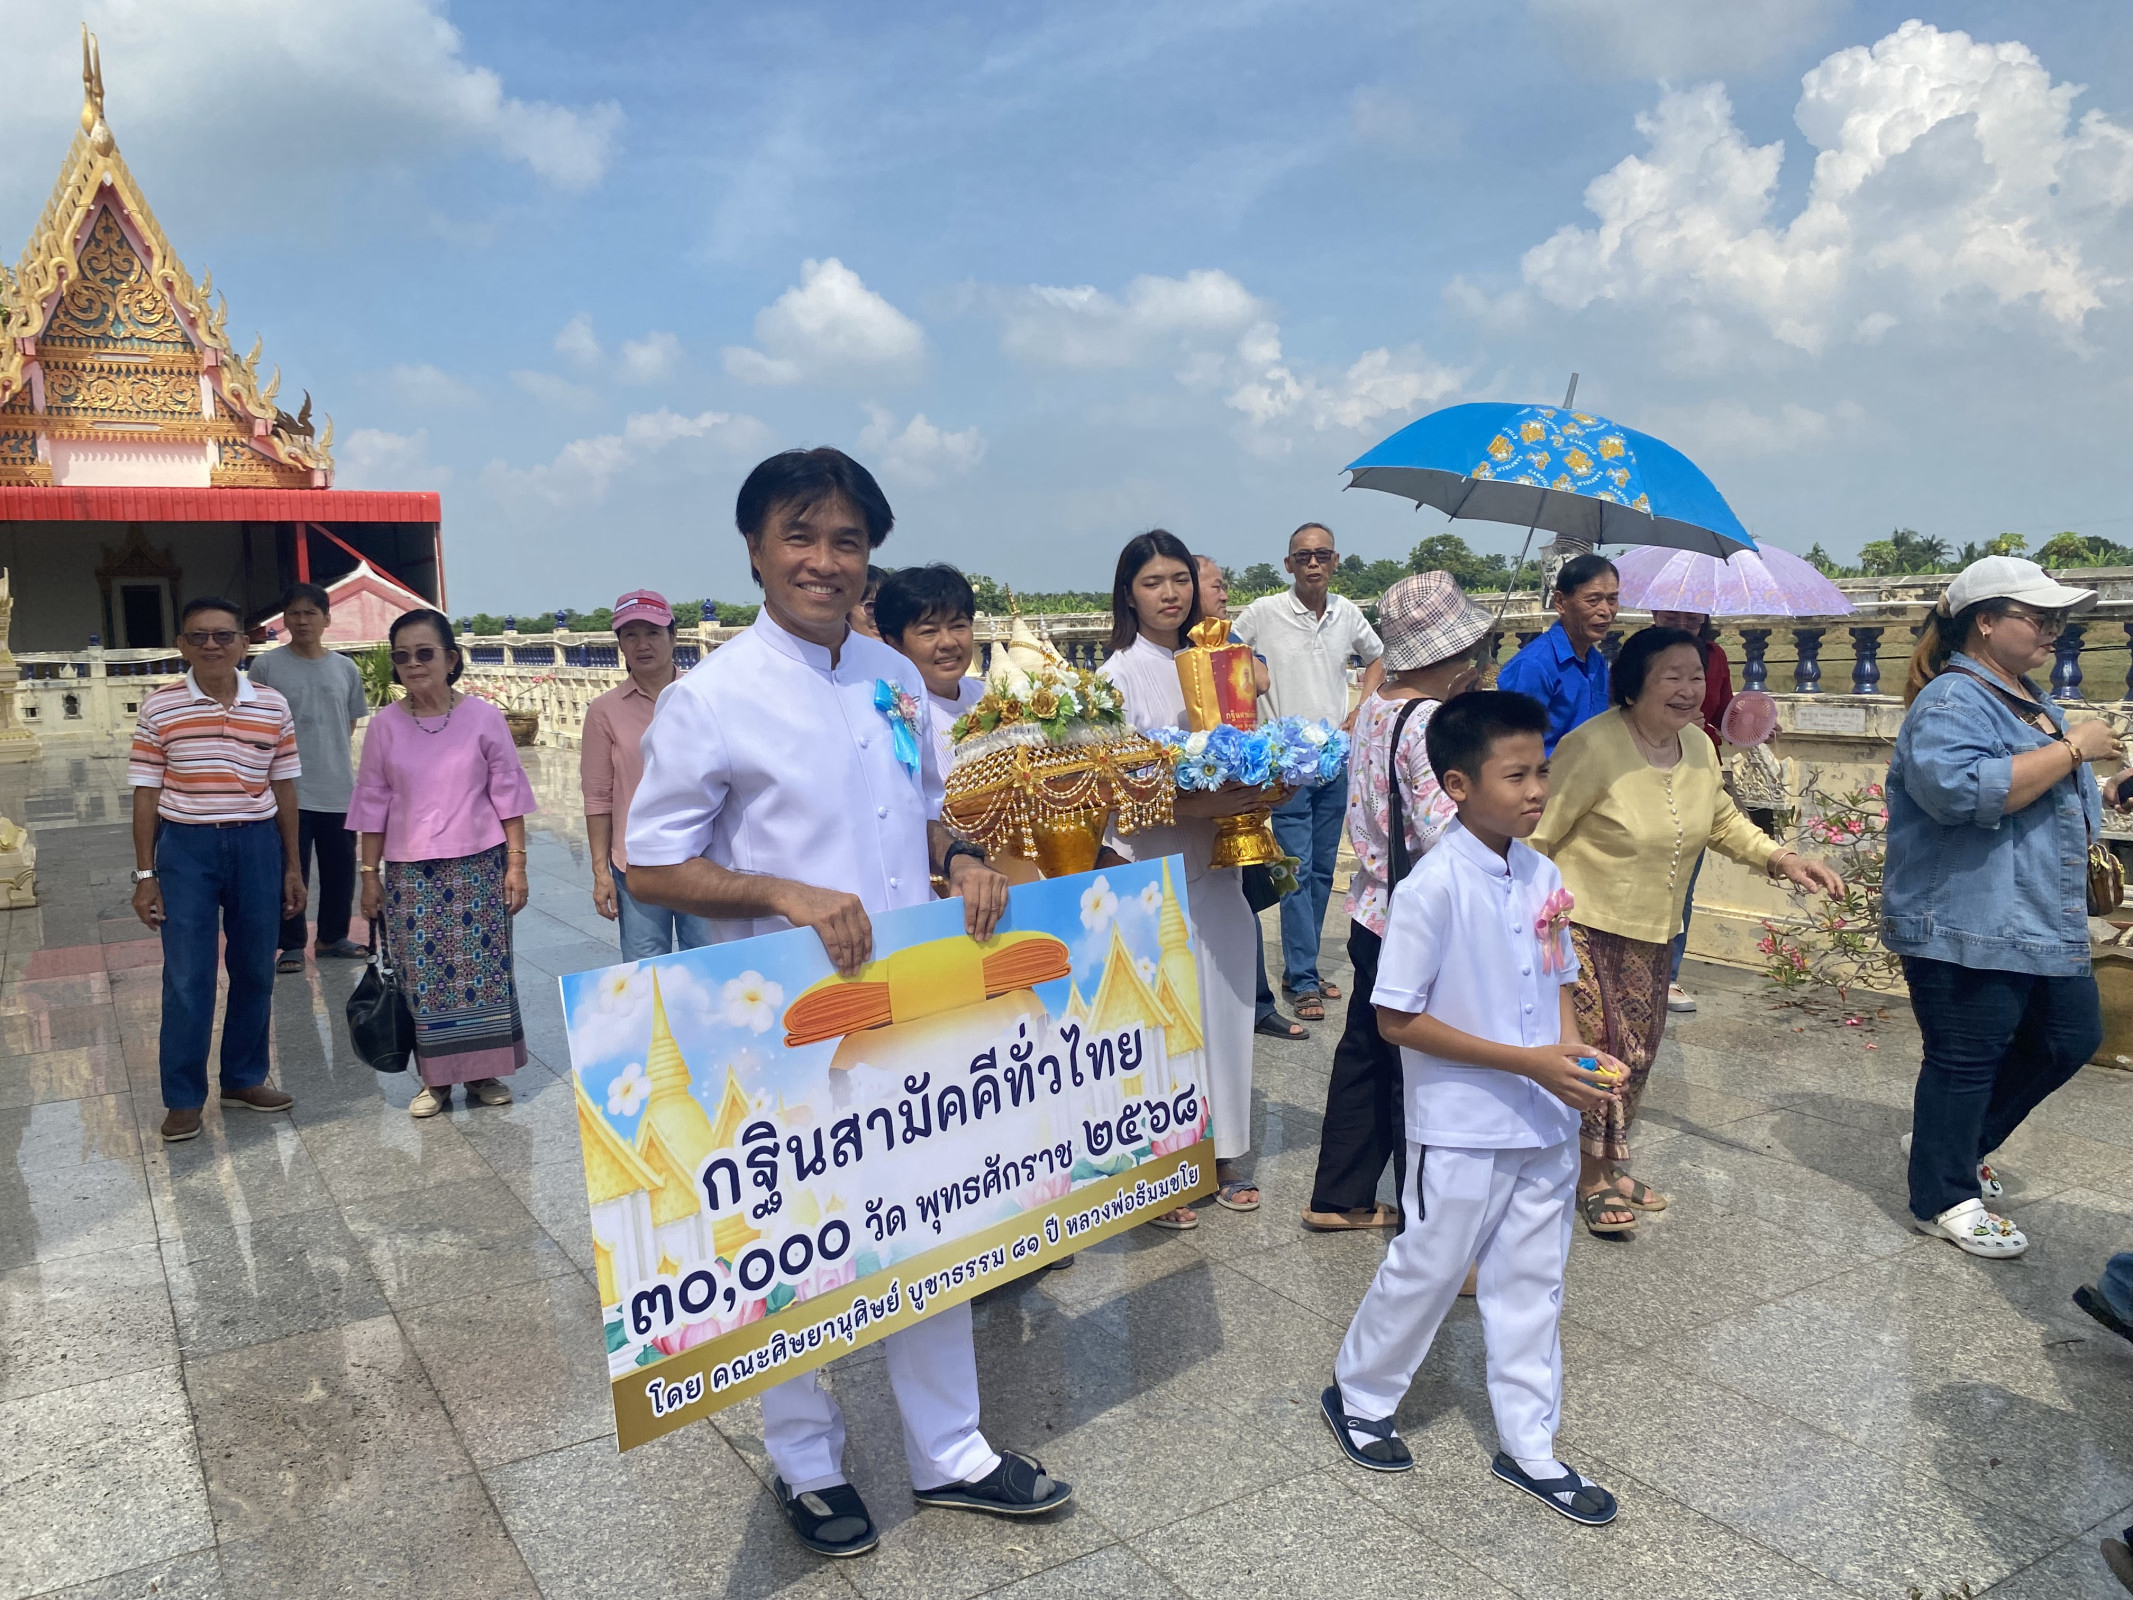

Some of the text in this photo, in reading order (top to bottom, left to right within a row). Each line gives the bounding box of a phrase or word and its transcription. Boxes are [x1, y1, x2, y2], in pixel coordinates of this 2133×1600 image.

[1527, 468, 1550, 488] GARFIEL
[631, 1083, 1198, 1335] ๓๐,๐๐๐ วัด พุทธศักราช ๒๕๖๘
[703, 1023, 1143, 1219] กฐินสามัคคีทั่วไทย
[649, 1163, 1199, 1414] โดย คณะศิษยานุศิษย์ บูชาธรรม ๘๑ ปี หลวงพ่อธัมมชโย
